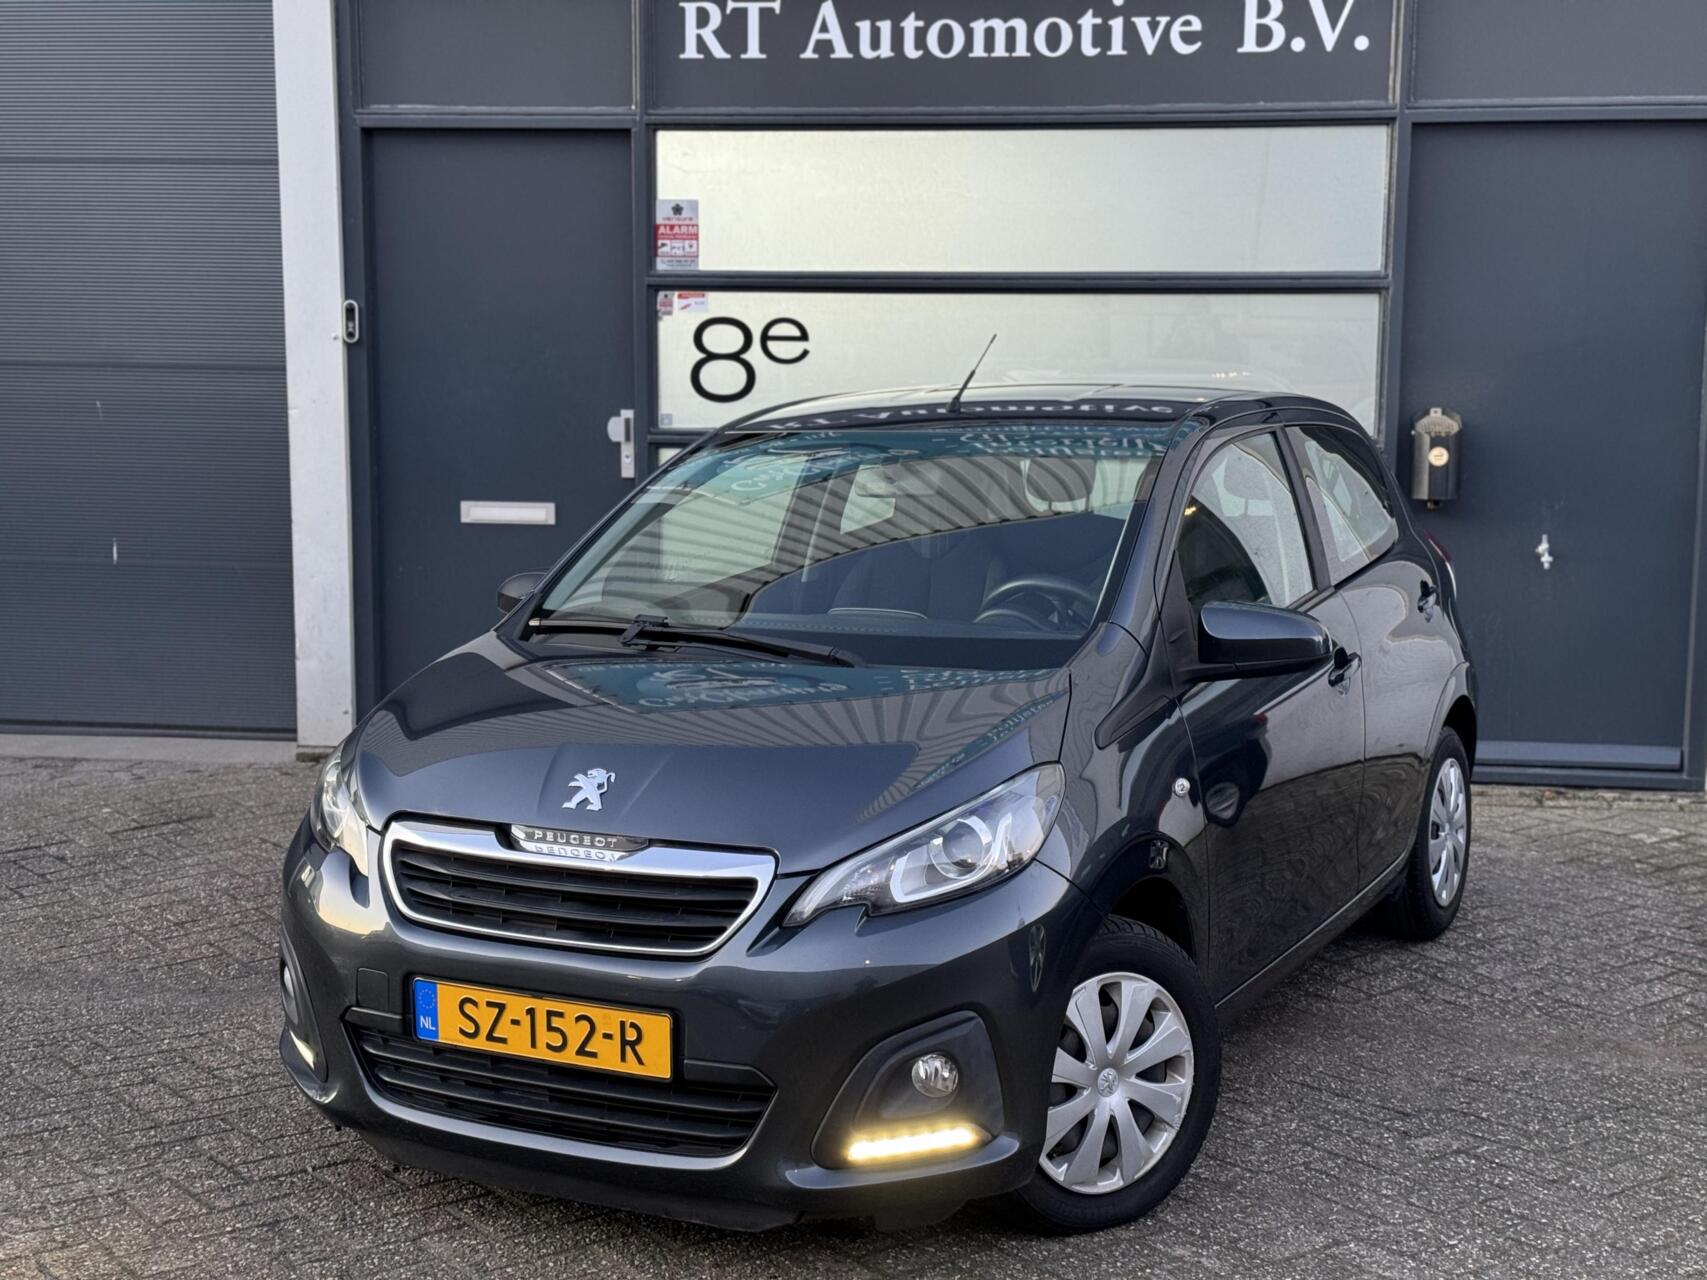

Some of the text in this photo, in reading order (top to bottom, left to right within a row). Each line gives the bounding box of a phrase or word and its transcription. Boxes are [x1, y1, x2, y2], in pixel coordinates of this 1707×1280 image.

[679, 0, 1370, 59] RT Automotive B.V.
[658, 225, 699, 235] ALARM
[690, 316, 810, 404] 8e
[533, 830, 618, 848] PEUGEOT
[420, 1016, 436, 1031] NL
[458, 996, 645, 1066] SZ-152-R
